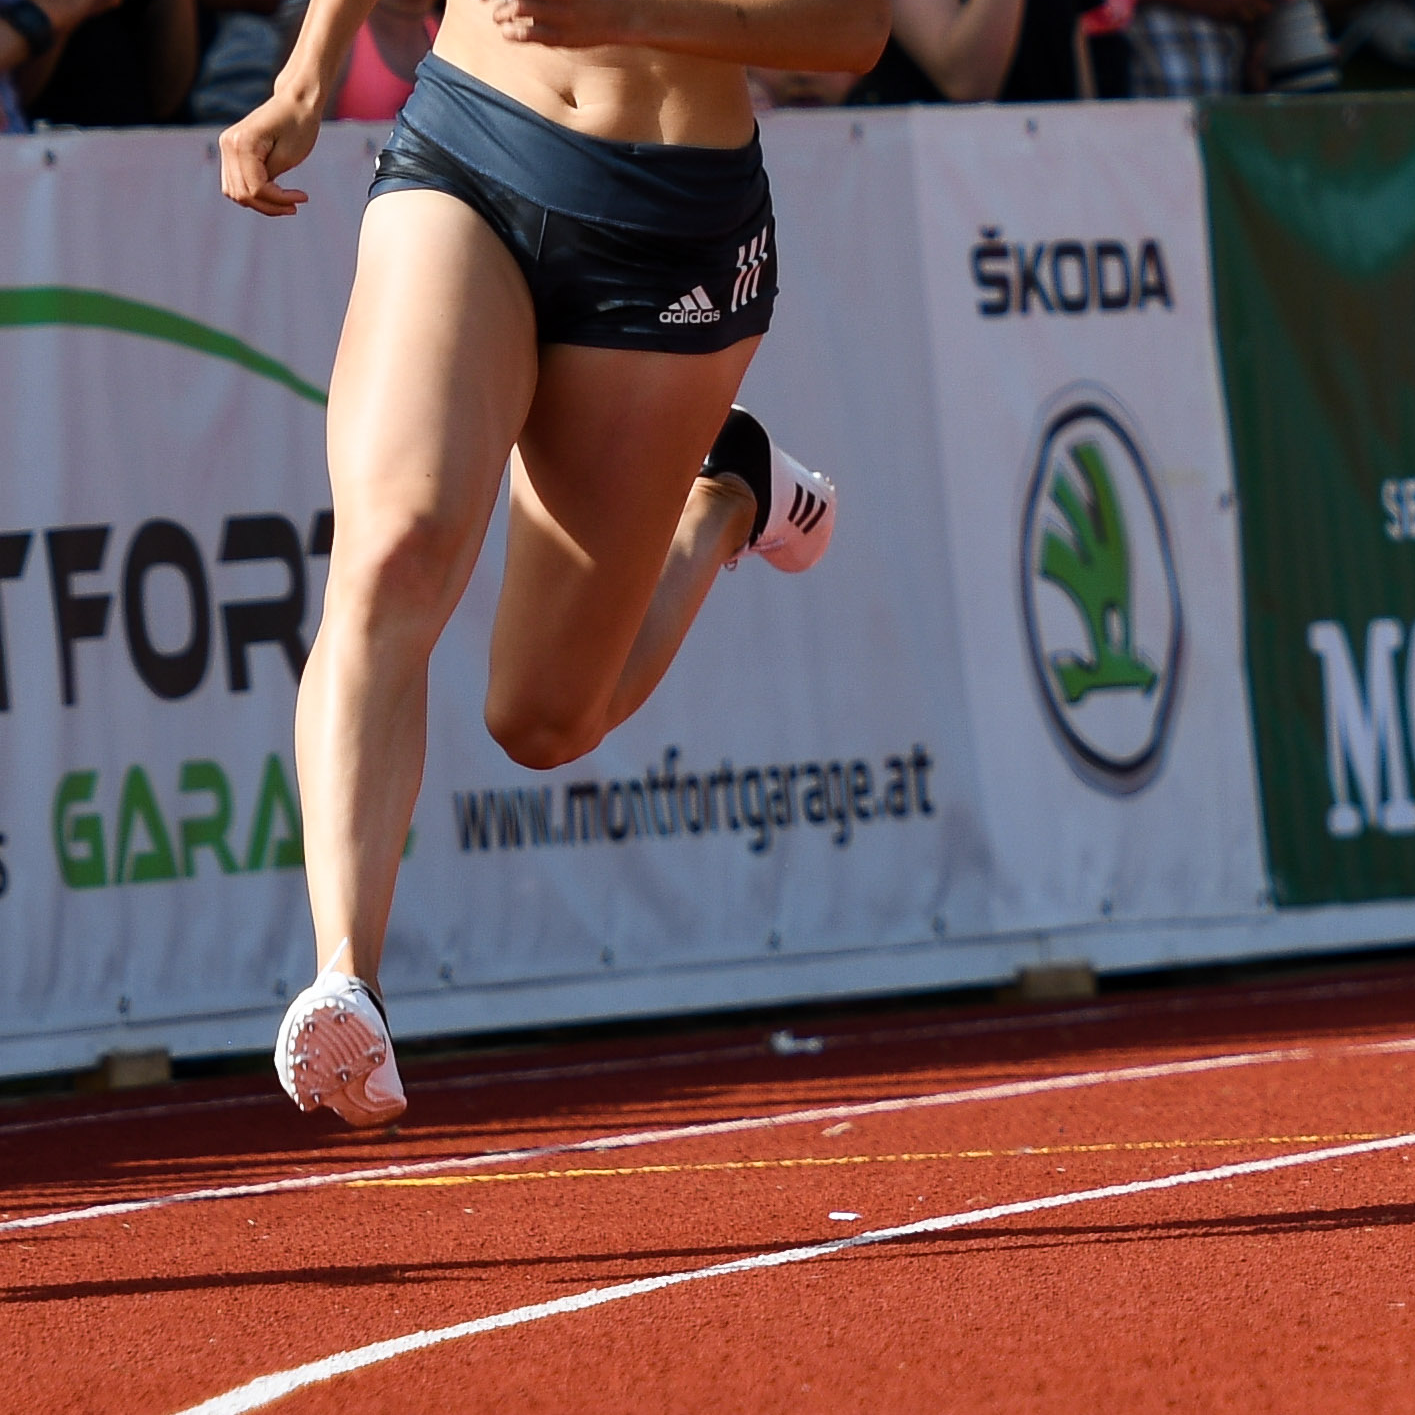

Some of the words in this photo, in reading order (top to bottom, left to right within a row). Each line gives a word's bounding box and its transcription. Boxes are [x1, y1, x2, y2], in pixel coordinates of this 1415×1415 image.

[660, 309, 720, 323] adidas
[970, 225, 1176, 317] ŠKODA
[51, 750, 415, 889] GARA
[454, 745, 934, 853] www.montfortgarage.at
